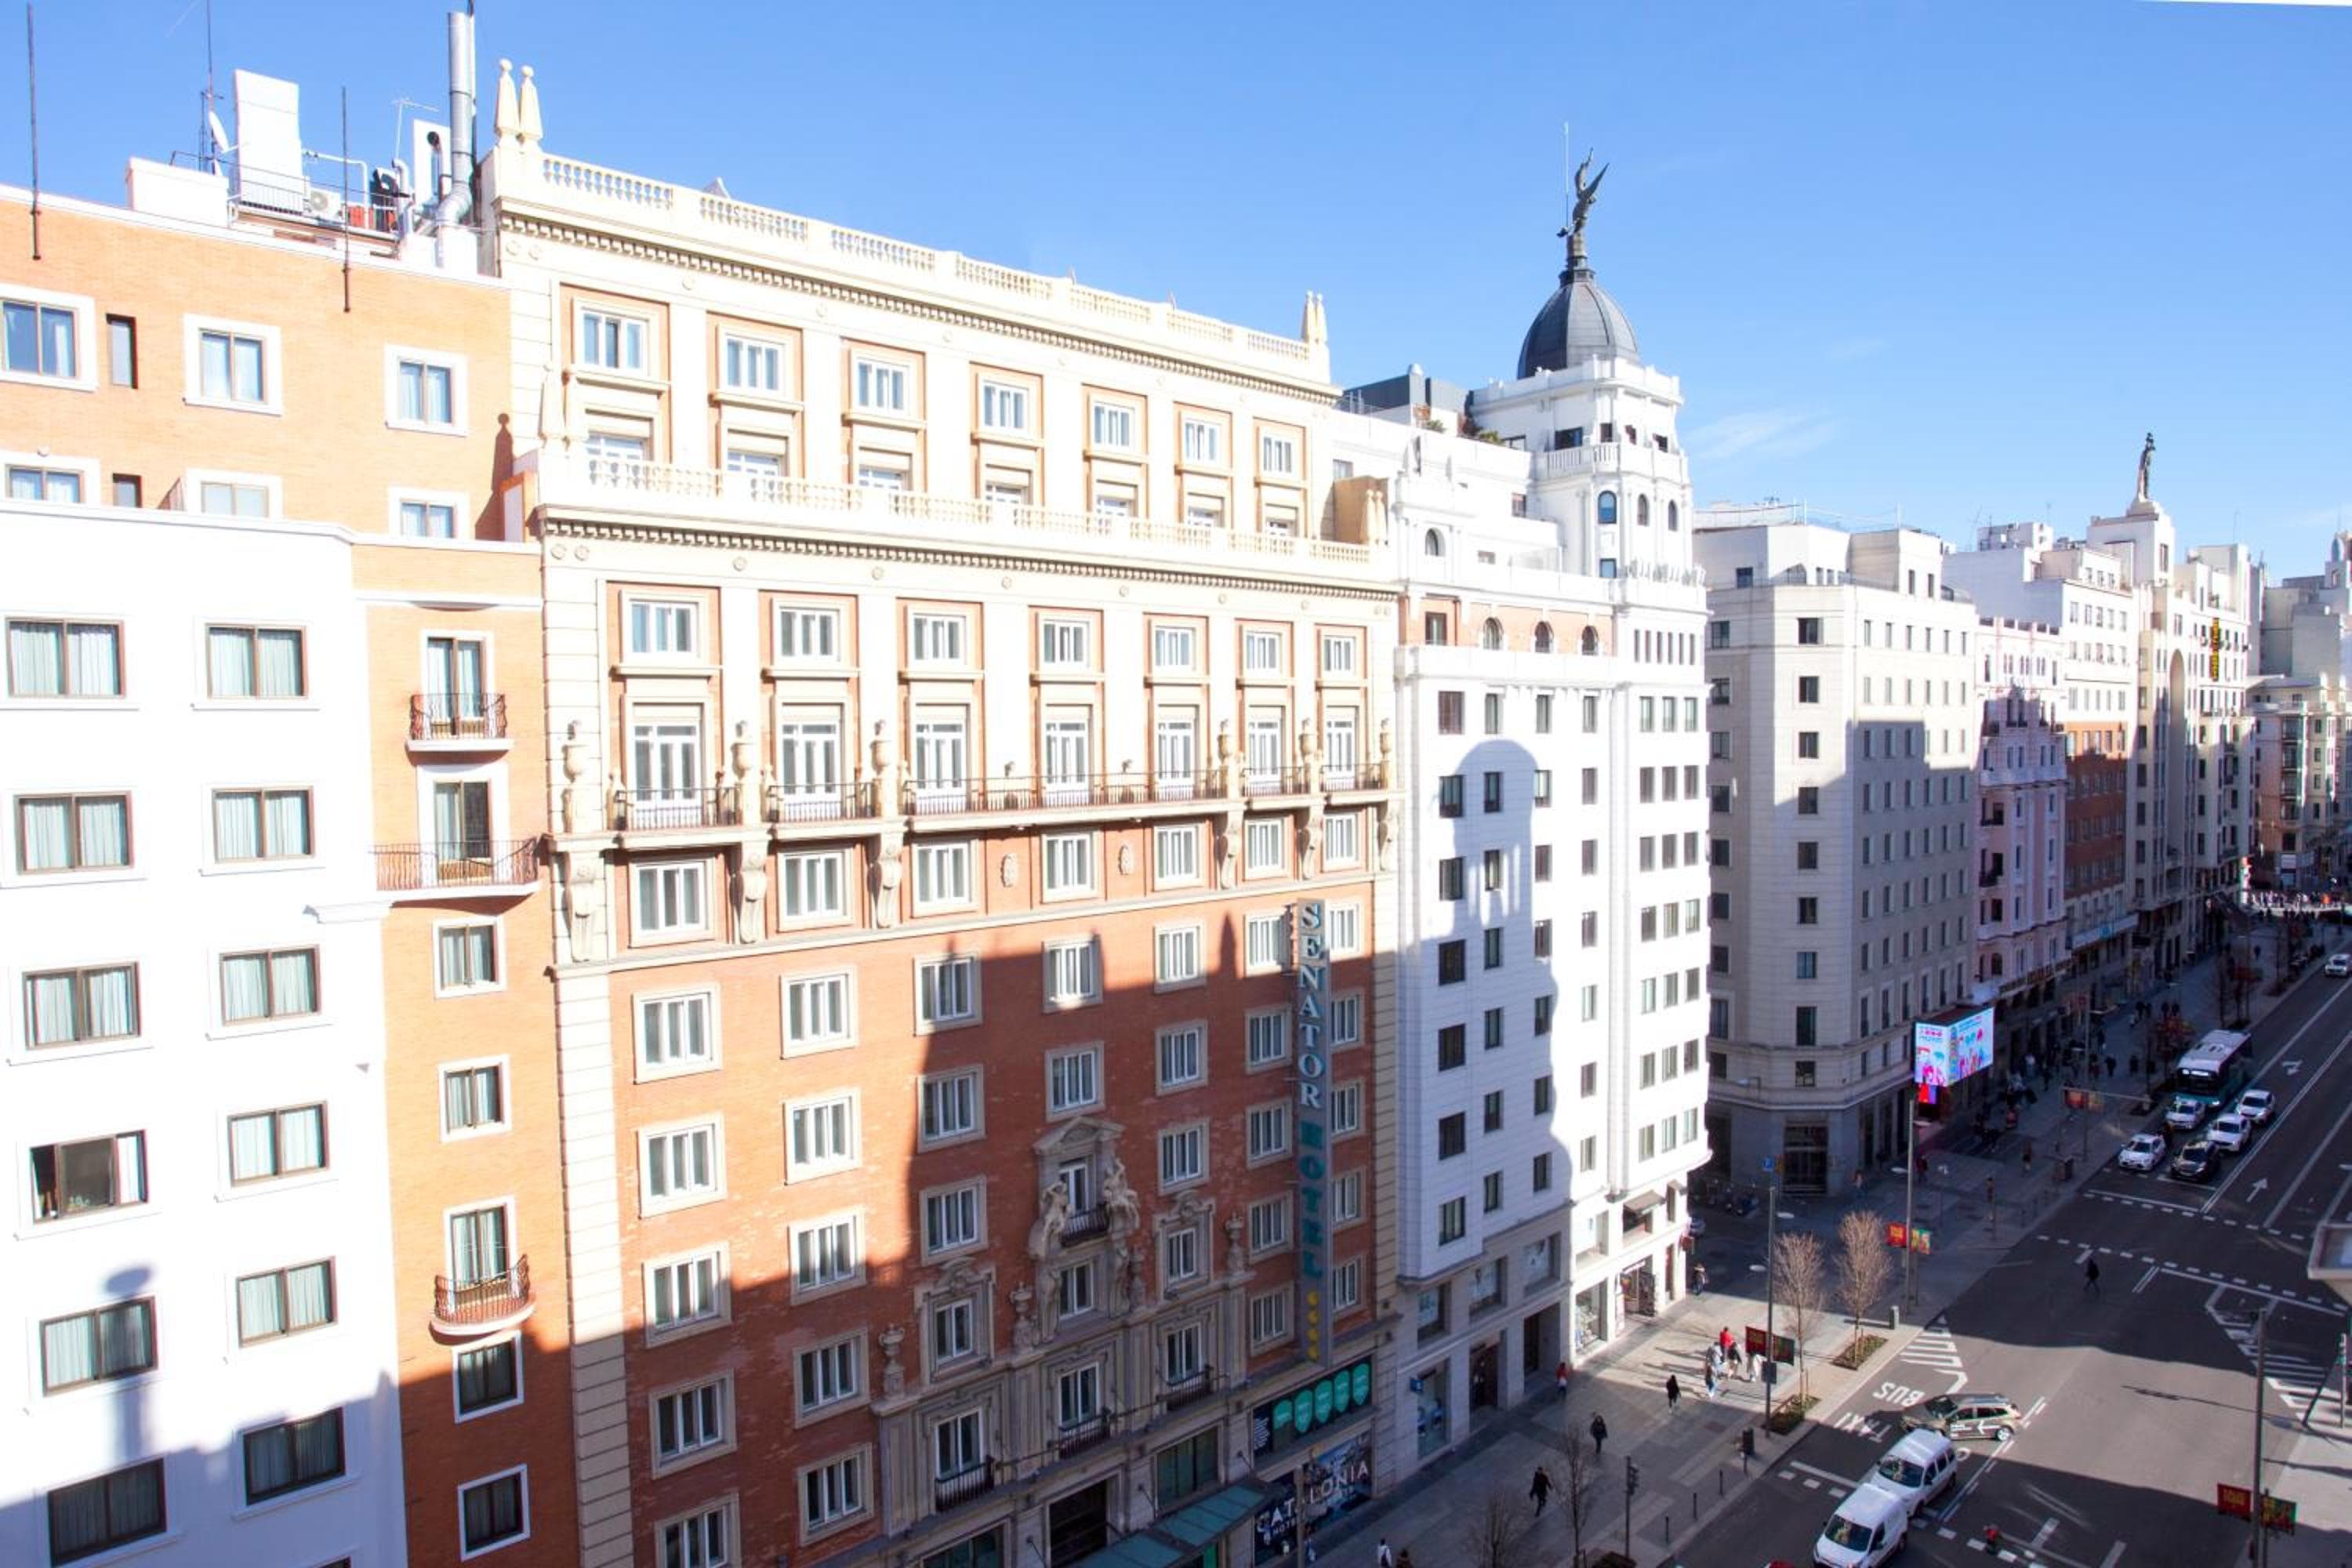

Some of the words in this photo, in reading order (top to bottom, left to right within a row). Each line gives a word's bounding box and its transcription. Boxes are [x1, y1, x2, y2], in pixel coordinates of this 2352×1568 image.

[1299, 902, 1322, 1109] SENATOR
[1872, 1382, 1926, 1407] BUS
[1833, 1413, 1893, 1443] TAXI
[1257, 1459, 1369, 1533] CATLONIA
